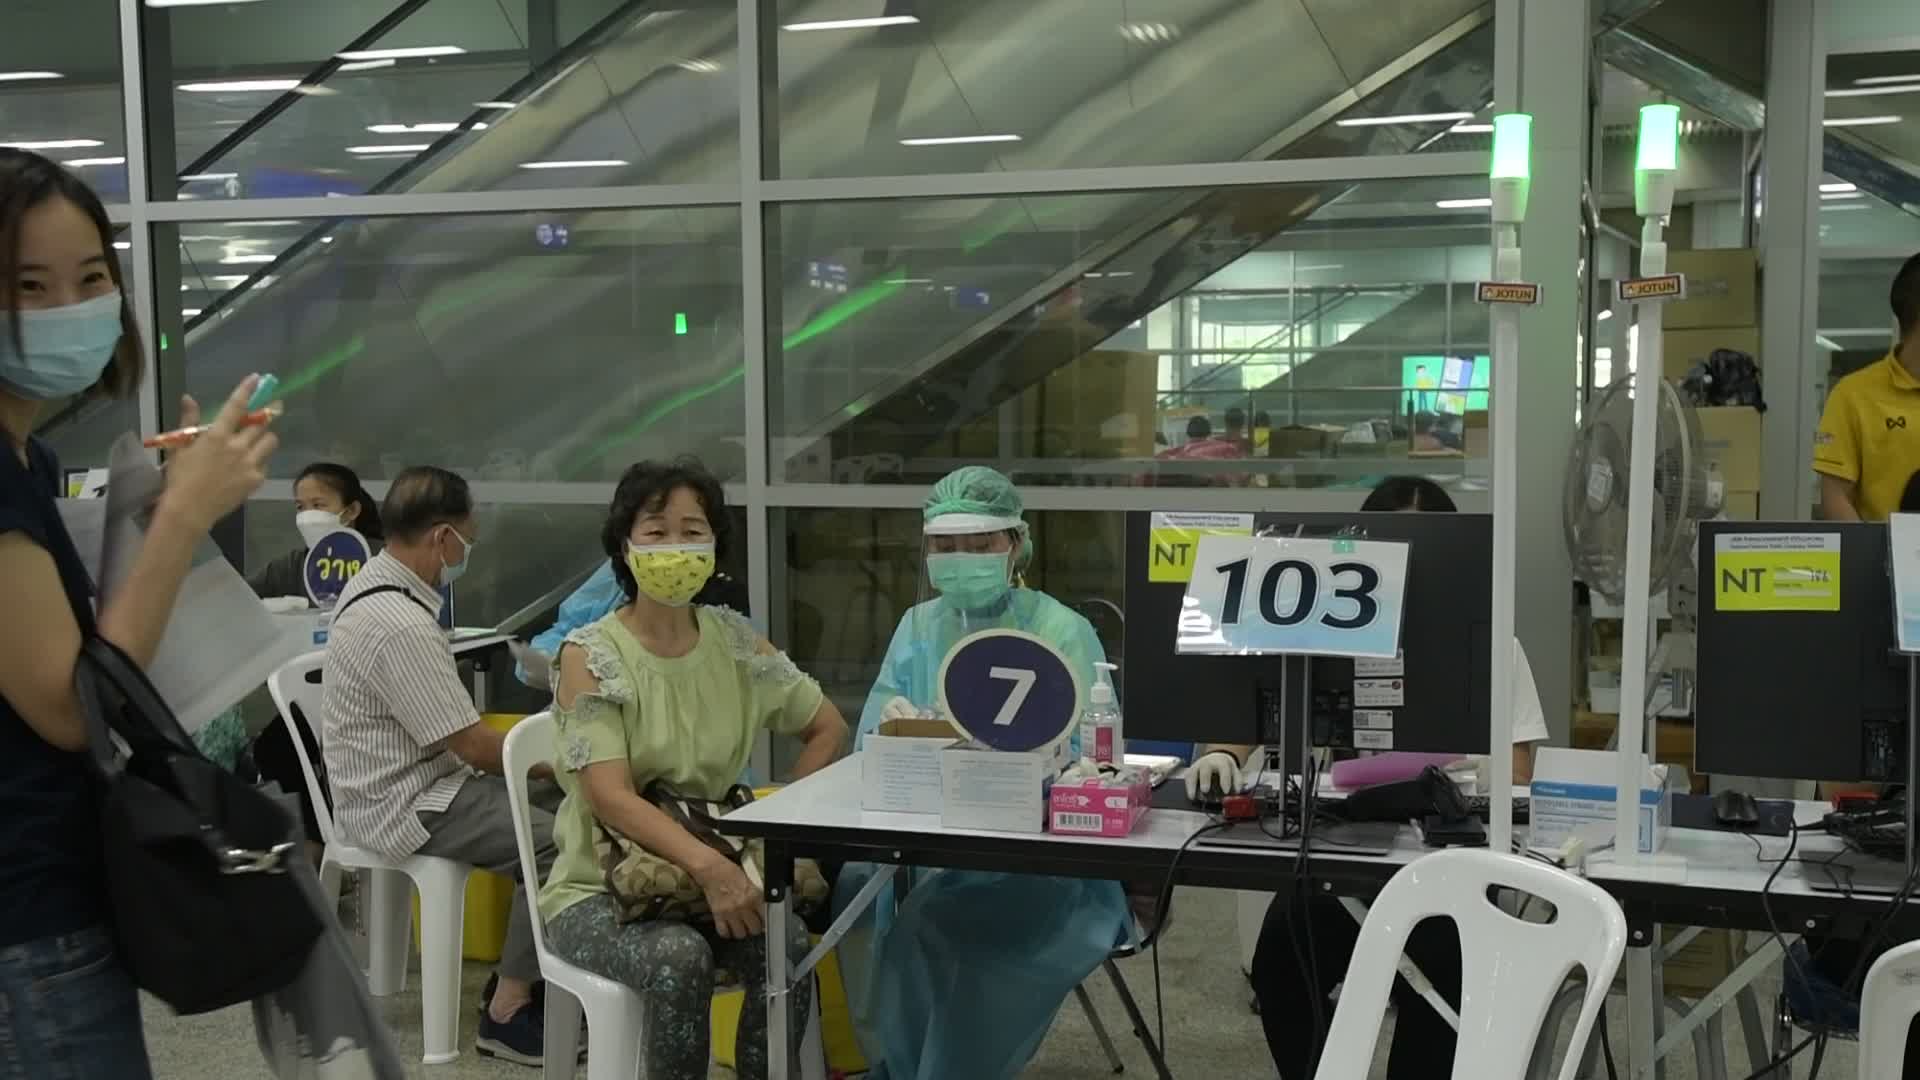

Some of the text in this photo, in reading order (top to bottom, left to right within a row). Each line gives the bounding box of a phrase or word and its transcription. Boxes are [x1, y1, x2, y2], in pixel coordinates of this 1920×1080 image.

[1495, 289, 1532, 300] JOTUN
[1637, 279, 1675, 295] JOTUN
[1154, 543, 1191, 567] NT
[1215, 556, 1380, 629] 103
[1722, 567, 1767, 593] NT
[989, 665, 1037, 726] 7
